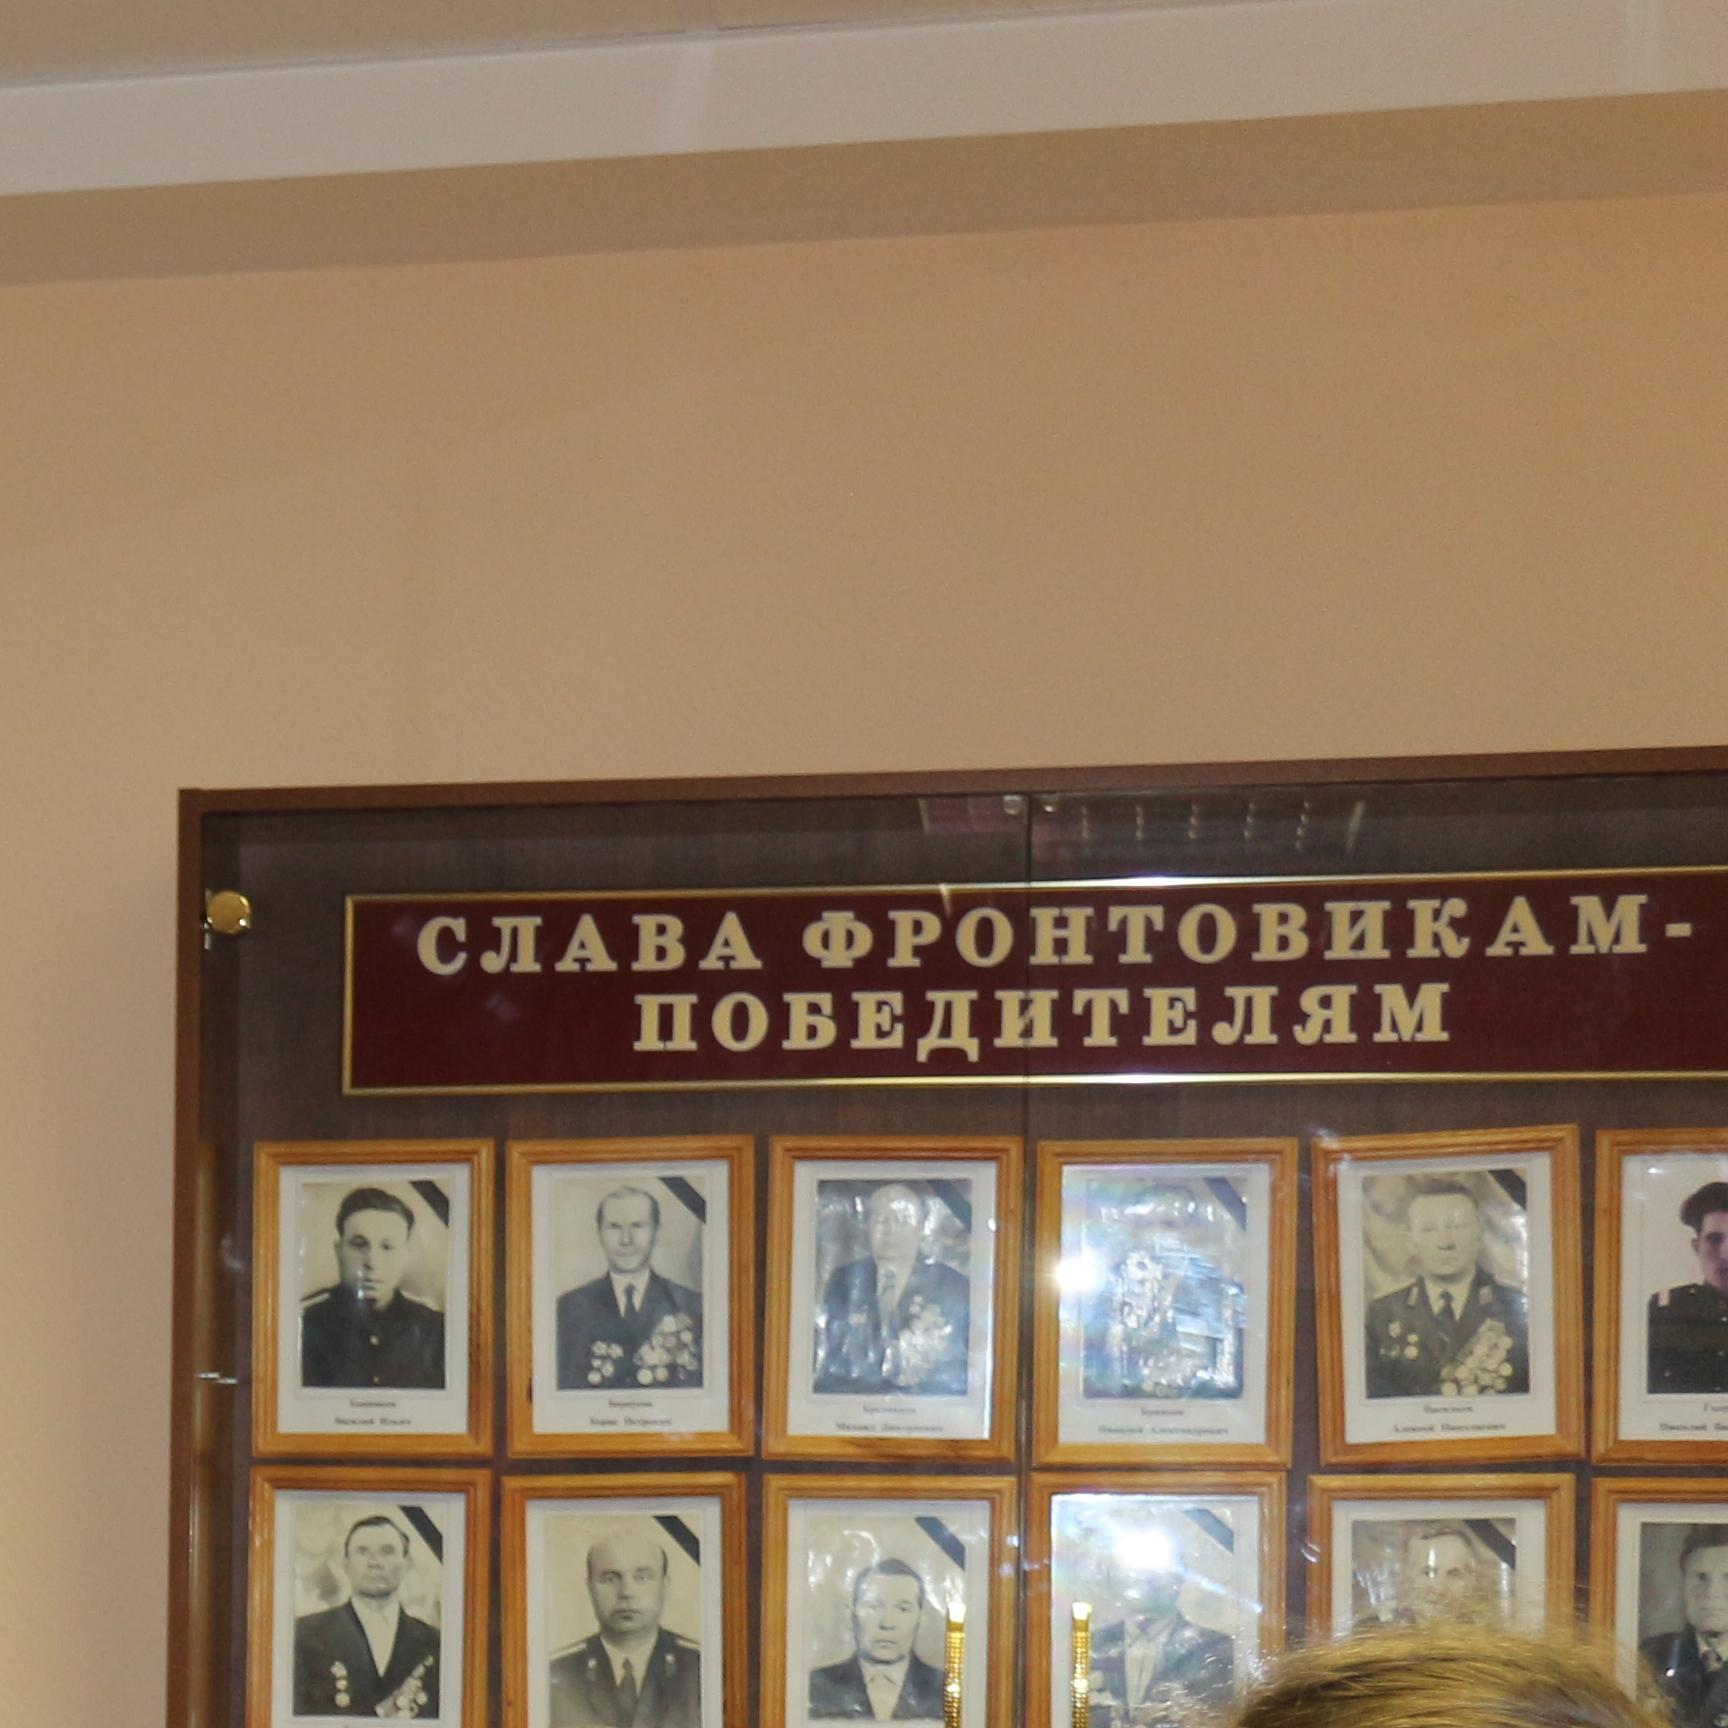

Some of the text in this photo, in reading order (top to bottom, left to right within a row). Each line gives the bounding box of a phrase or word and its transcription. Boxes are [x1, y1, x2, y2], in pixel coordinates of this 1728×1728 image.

[415, 893, 1694, 976] СЛАВА ФРОНТОВИКАМ-
[632, 981, 1451, 1063] ПОБЕДИТЕЛЯМ
